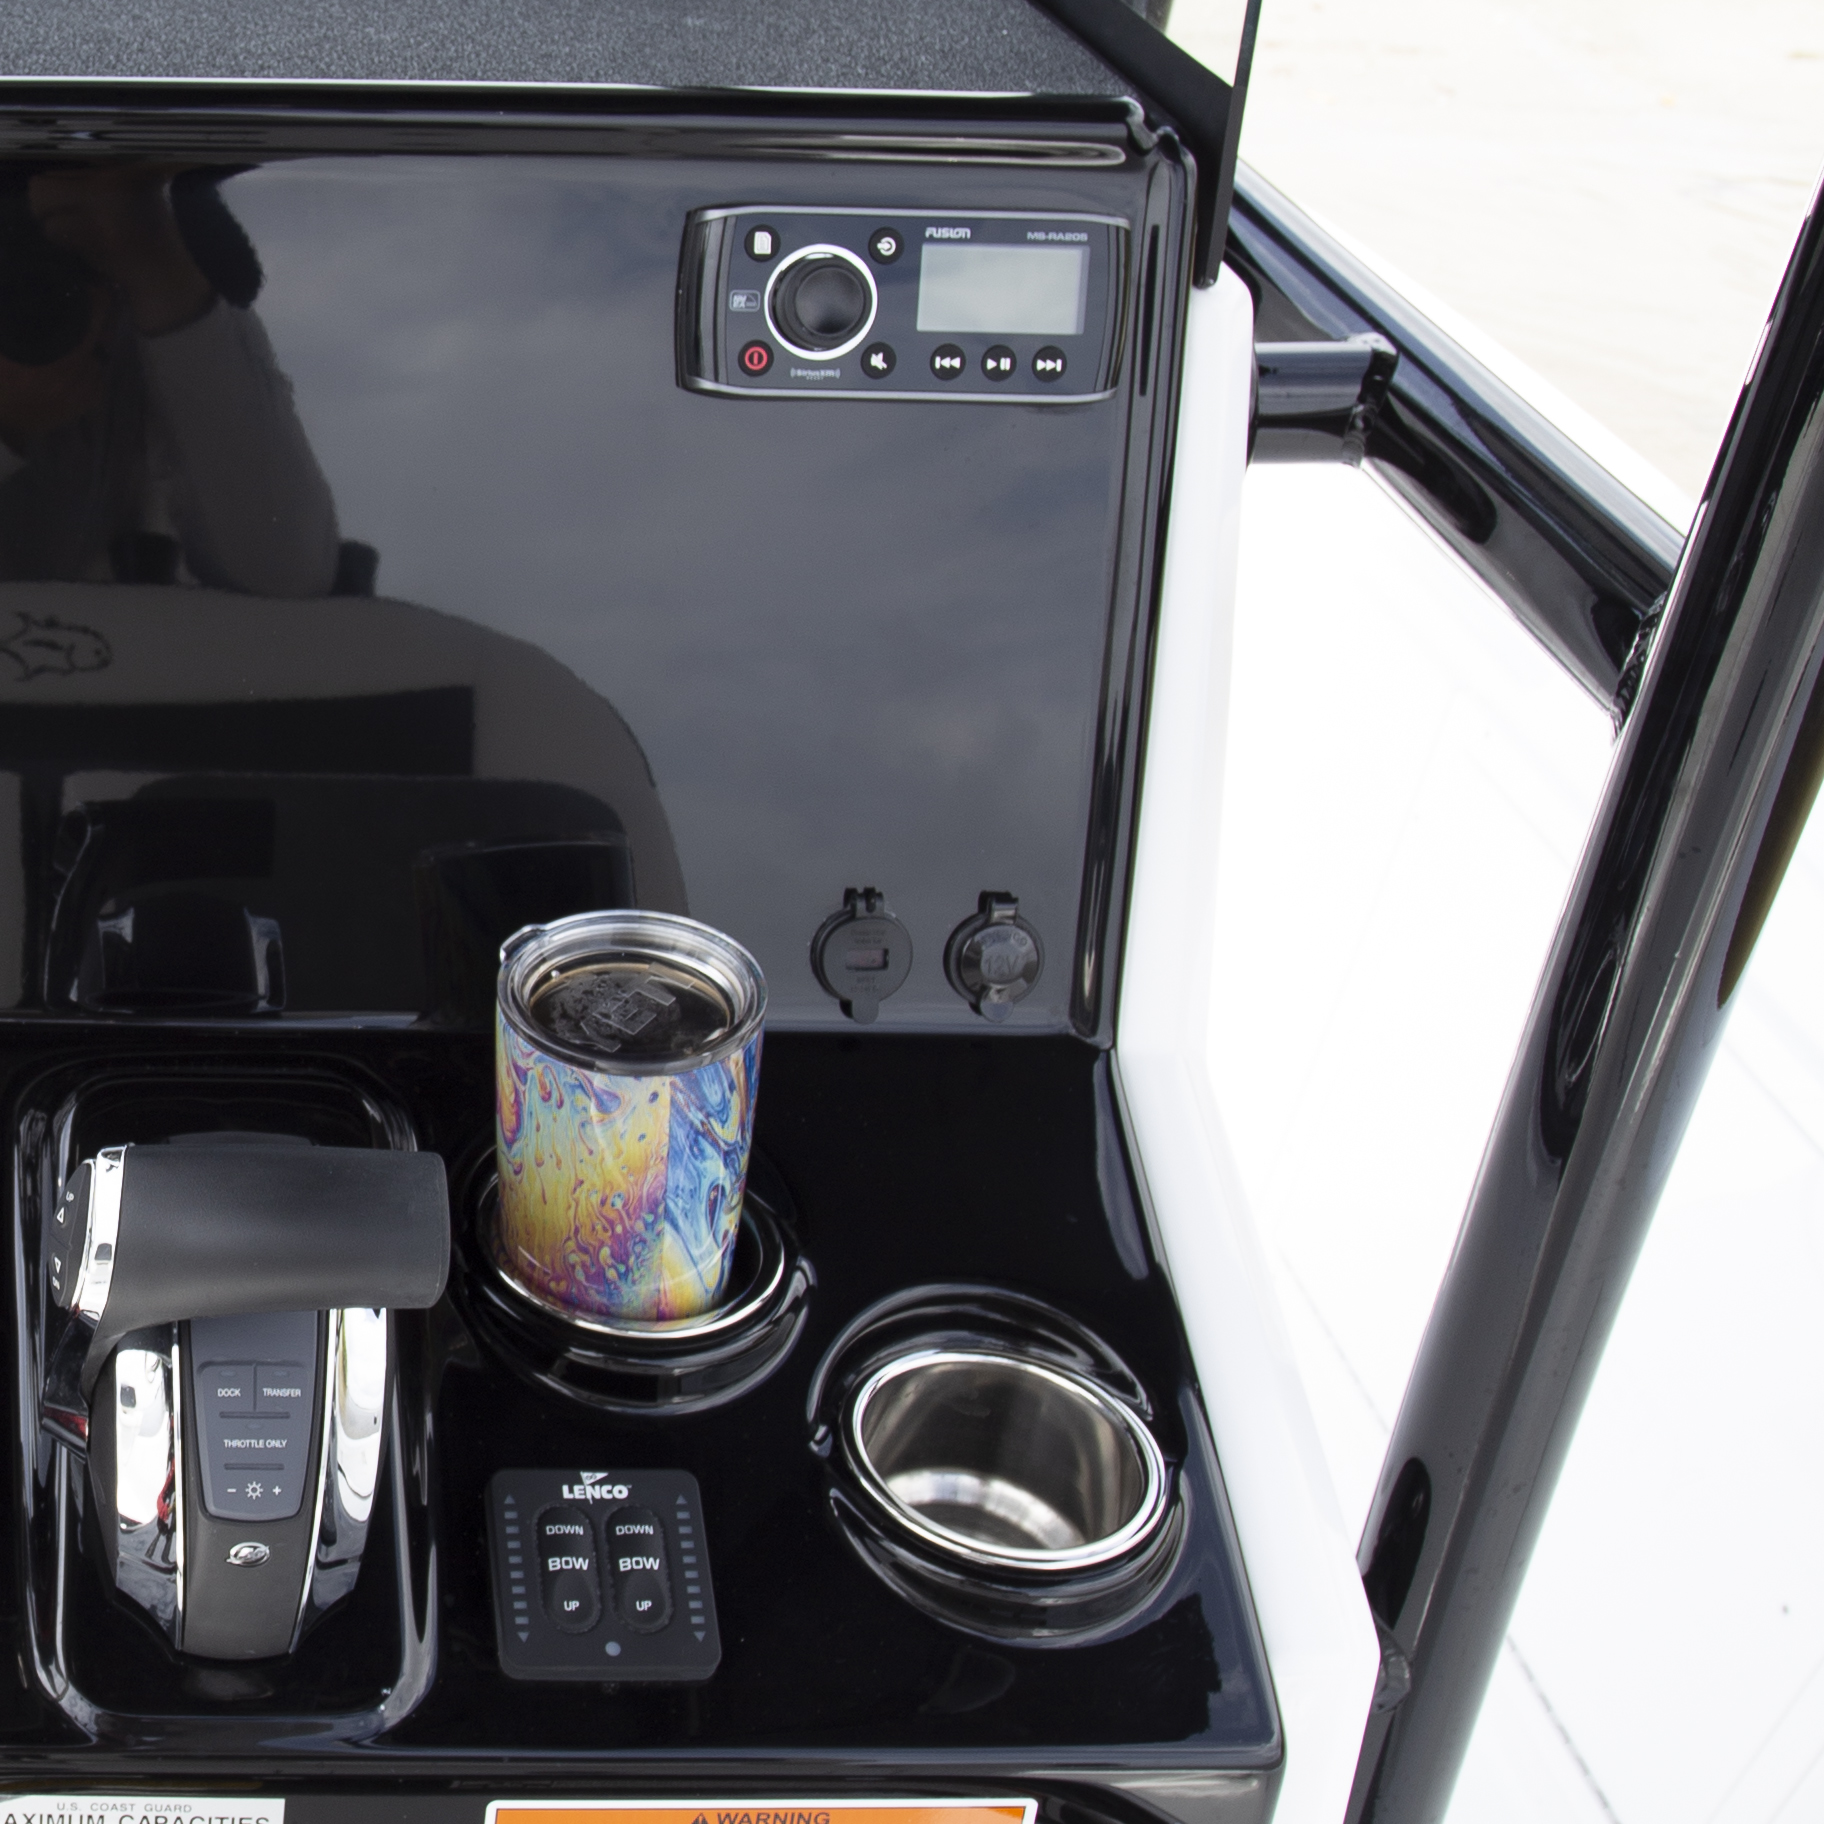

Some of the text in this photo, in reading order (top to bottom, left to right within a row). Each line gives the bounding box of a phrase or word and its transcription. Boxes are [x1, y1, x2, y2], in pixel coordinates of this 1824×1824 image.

[926, 227, 971, 239] FUSION
[217, 1388, 301, 1398] DOCK TRANSFER
[223, 1439, 287, 1448] THROTTLE ONLY
[562, 1484, 629, 1500] LENCO
[546, 1525, 584, 1535] DOWN
[615, 1525, 654, 1535] DOWN
[548, 1556, 589, 1571] BOW
[619, 1556, 660, 1571] BOW
[563, 1600, 580, 1612] UP
[635, 1600, 652, 1612] UP
[57, 1802, 192, 1813] U.S. COAST GUARD
